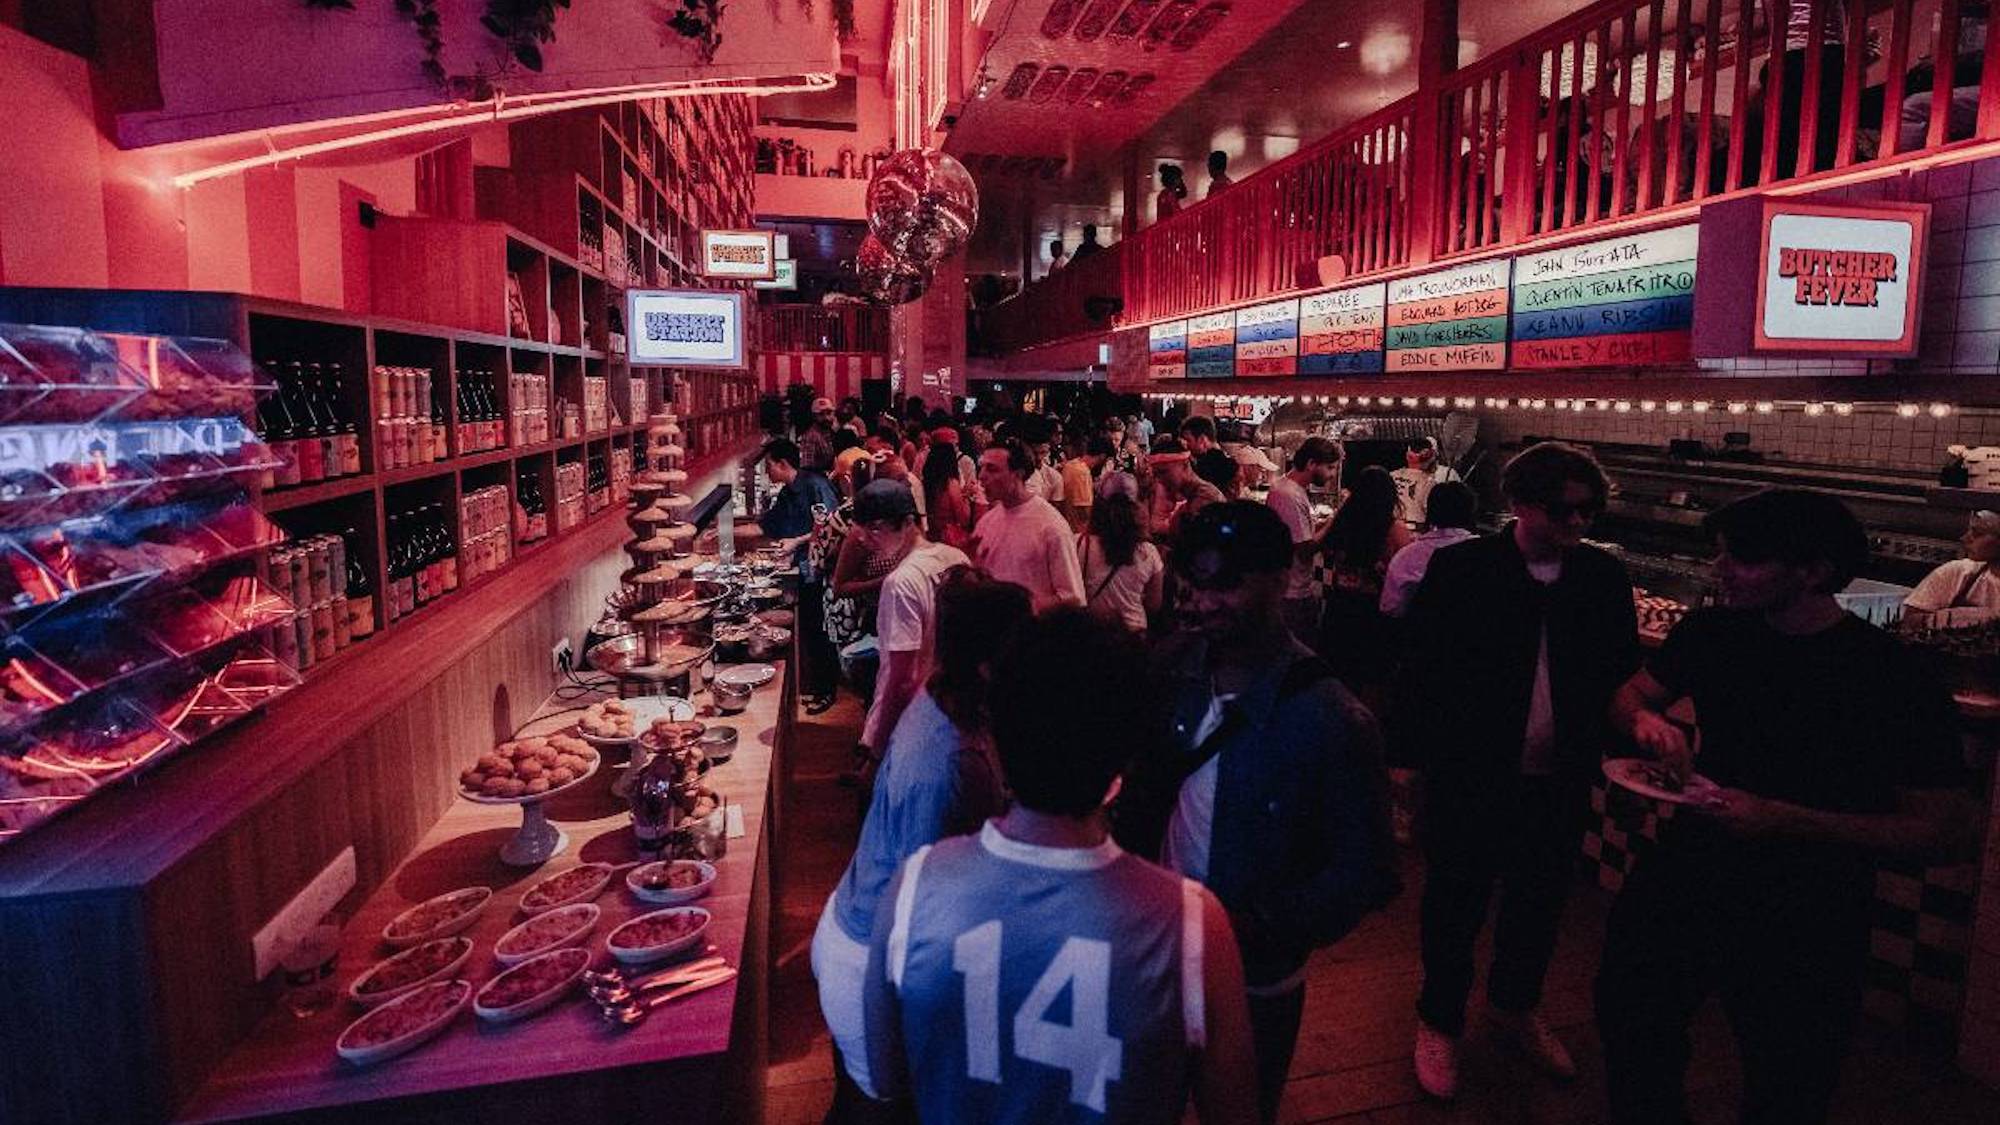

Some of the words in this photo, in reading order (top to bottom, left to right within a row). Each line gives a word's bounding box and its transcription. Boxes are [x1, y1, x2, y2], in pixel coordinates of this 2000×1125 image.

[1779, 248, 1897, 282] BUTCHER
[1795, 275, 1878, 307] FEVER
[647, 324, 724, 343] STATION
[1401, 352, 1438, 366] EDDIE
[953, 919, 1123, 1114] 14
